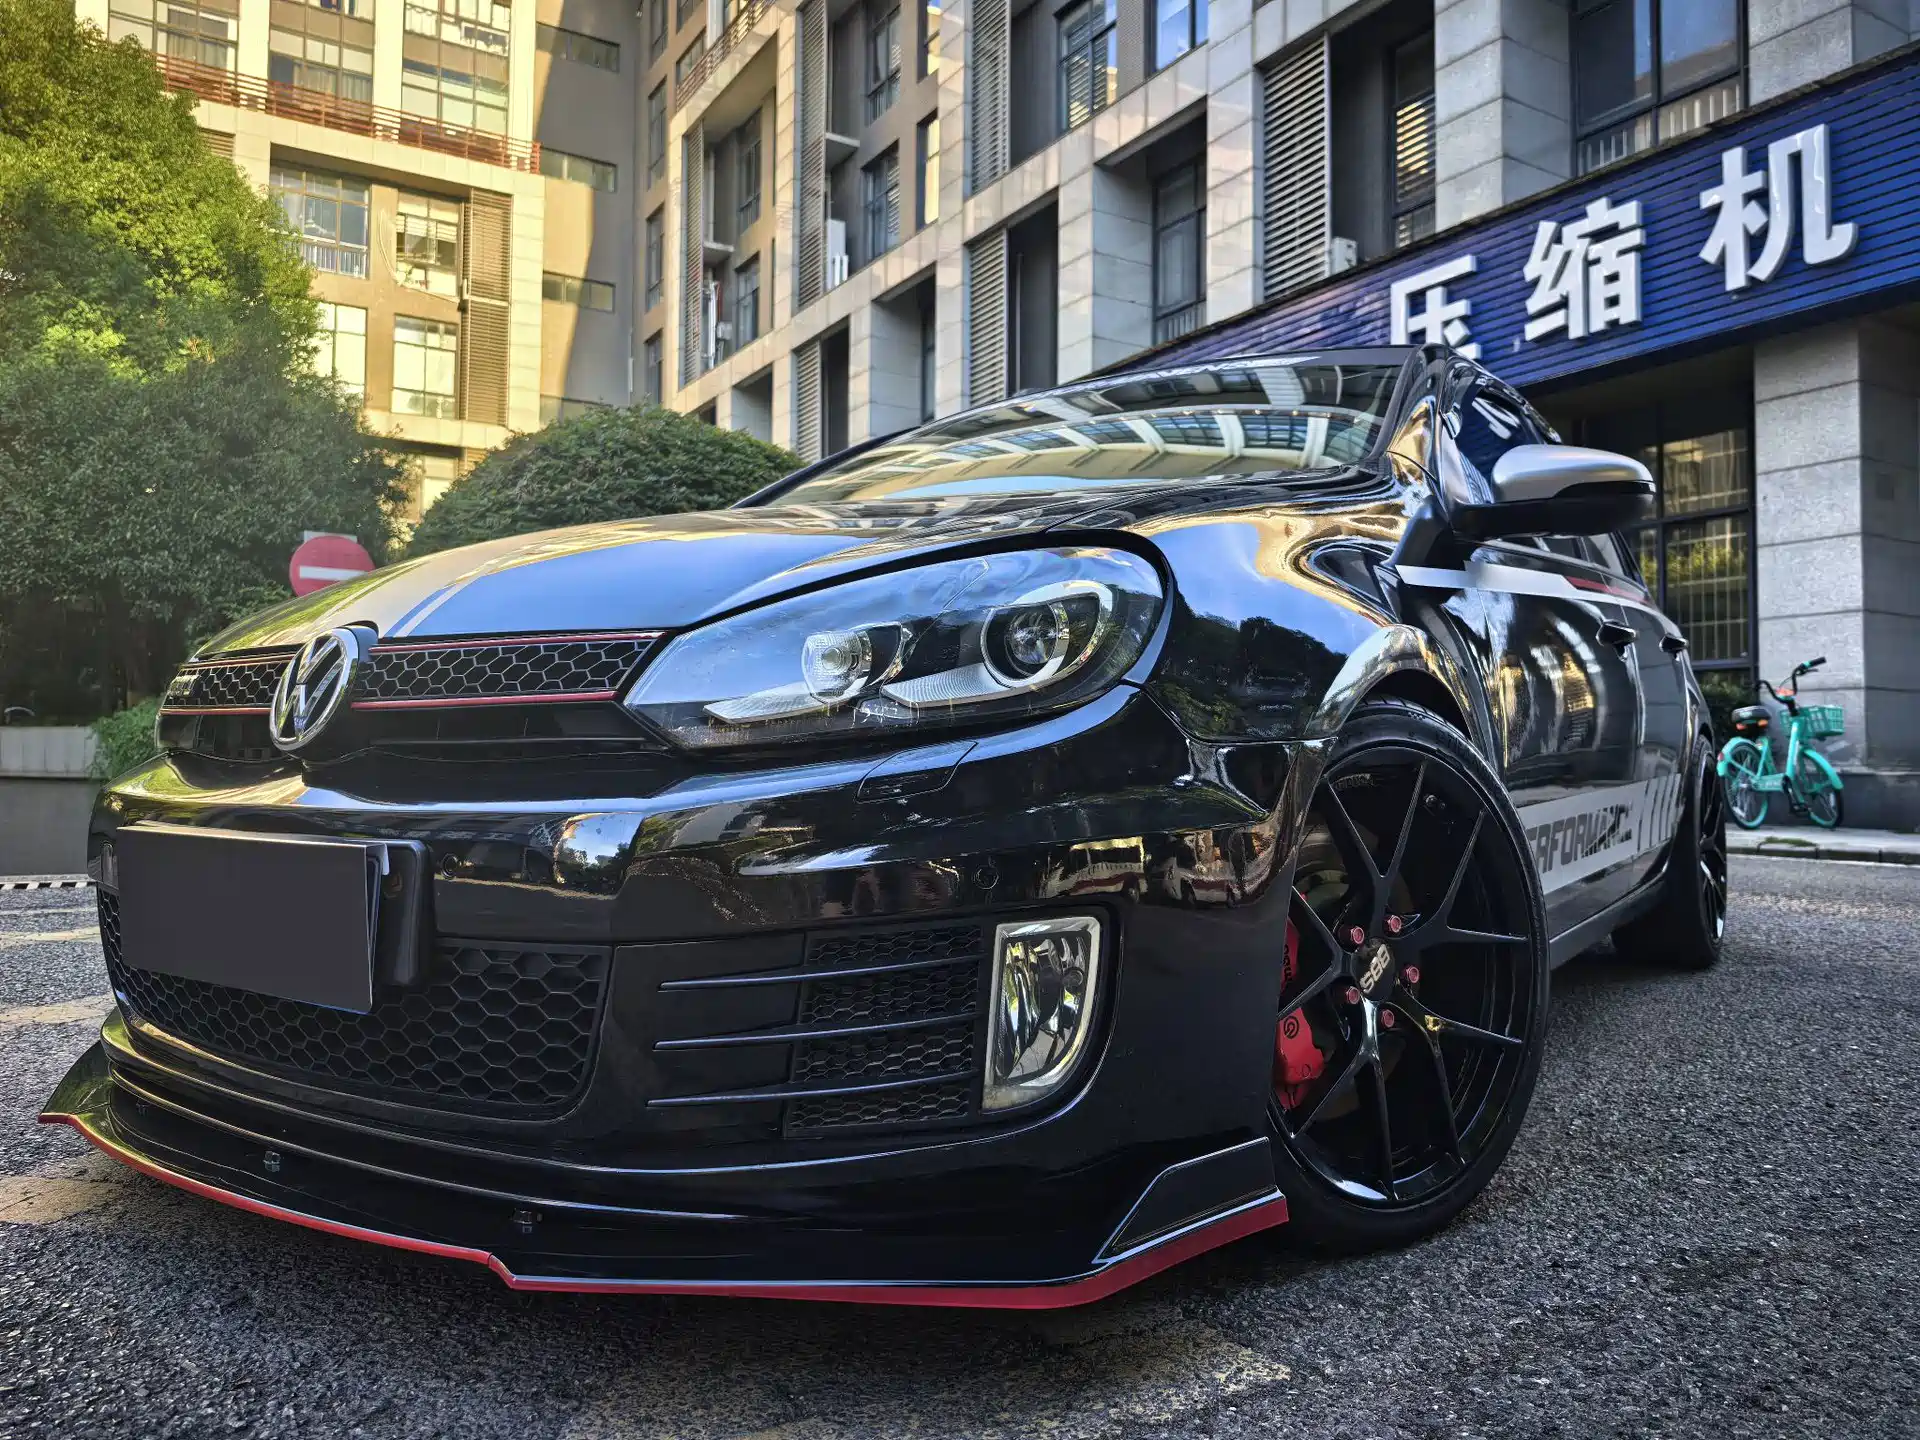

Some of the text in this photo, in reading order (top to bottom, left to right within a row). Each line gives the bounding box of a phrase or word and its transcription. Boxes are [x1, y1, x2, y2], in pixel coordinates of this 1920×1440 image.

[1390, 123, 1858, 361] 压缩机
[1359, 943, 1391, 993] BBS
